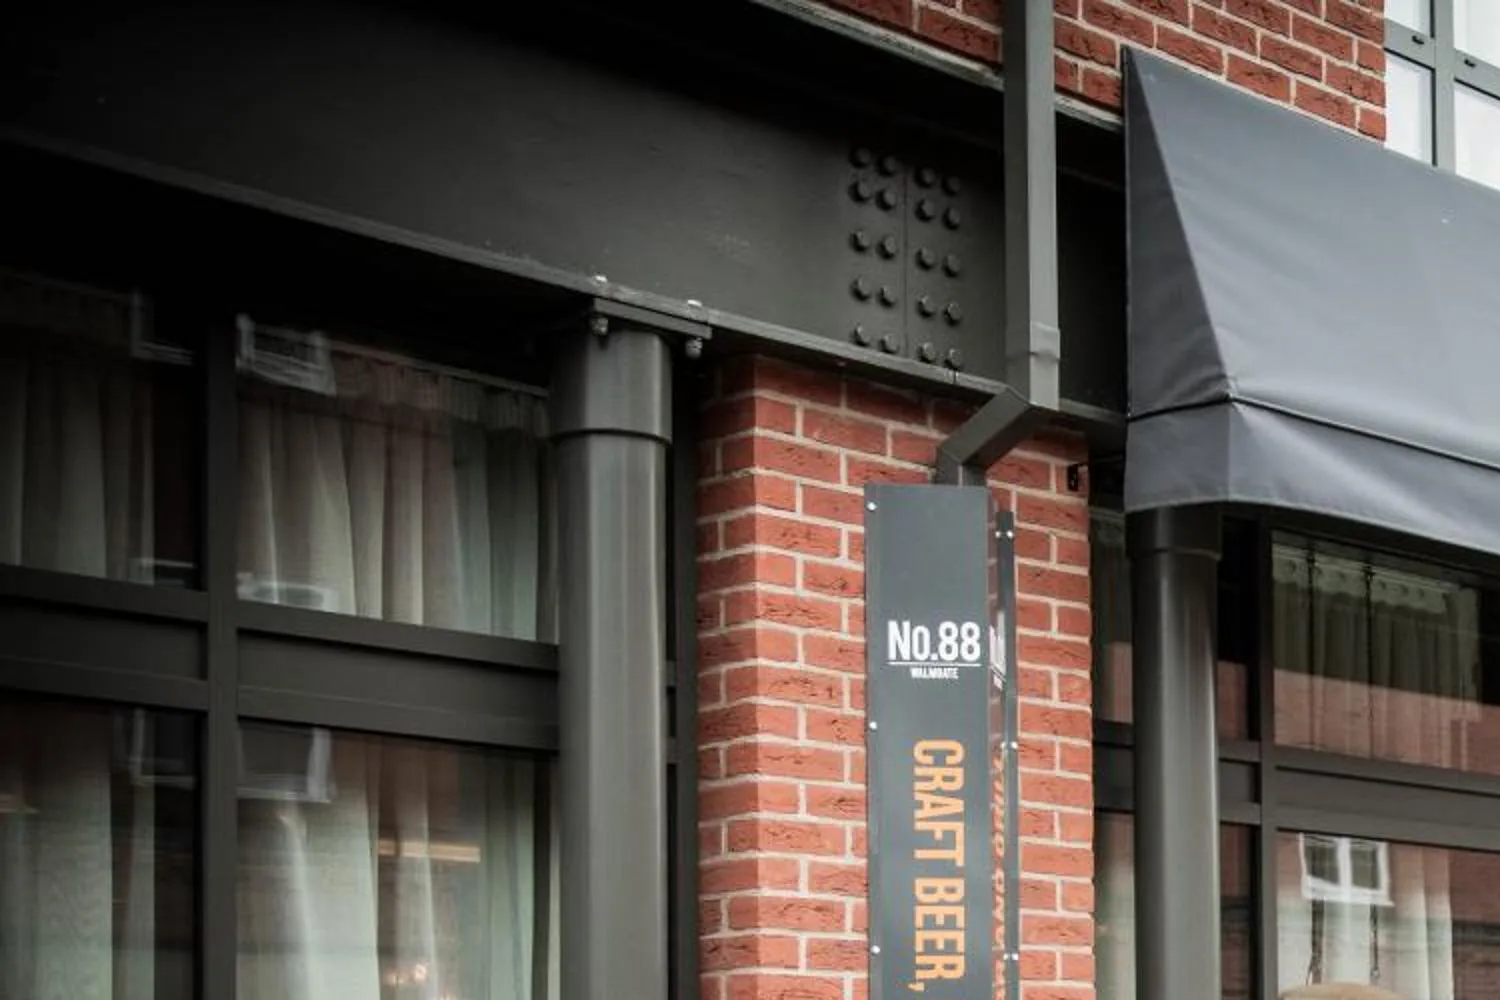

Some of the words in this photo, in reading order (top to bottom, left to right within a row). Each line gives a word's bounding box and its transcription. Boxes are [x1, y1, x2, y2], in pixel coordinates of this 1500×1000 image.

[910, 667, 959, 680] WALMGATE
[913, 739, 965, 866] CRAFT
[908, 877, 966, 992] BEER,
